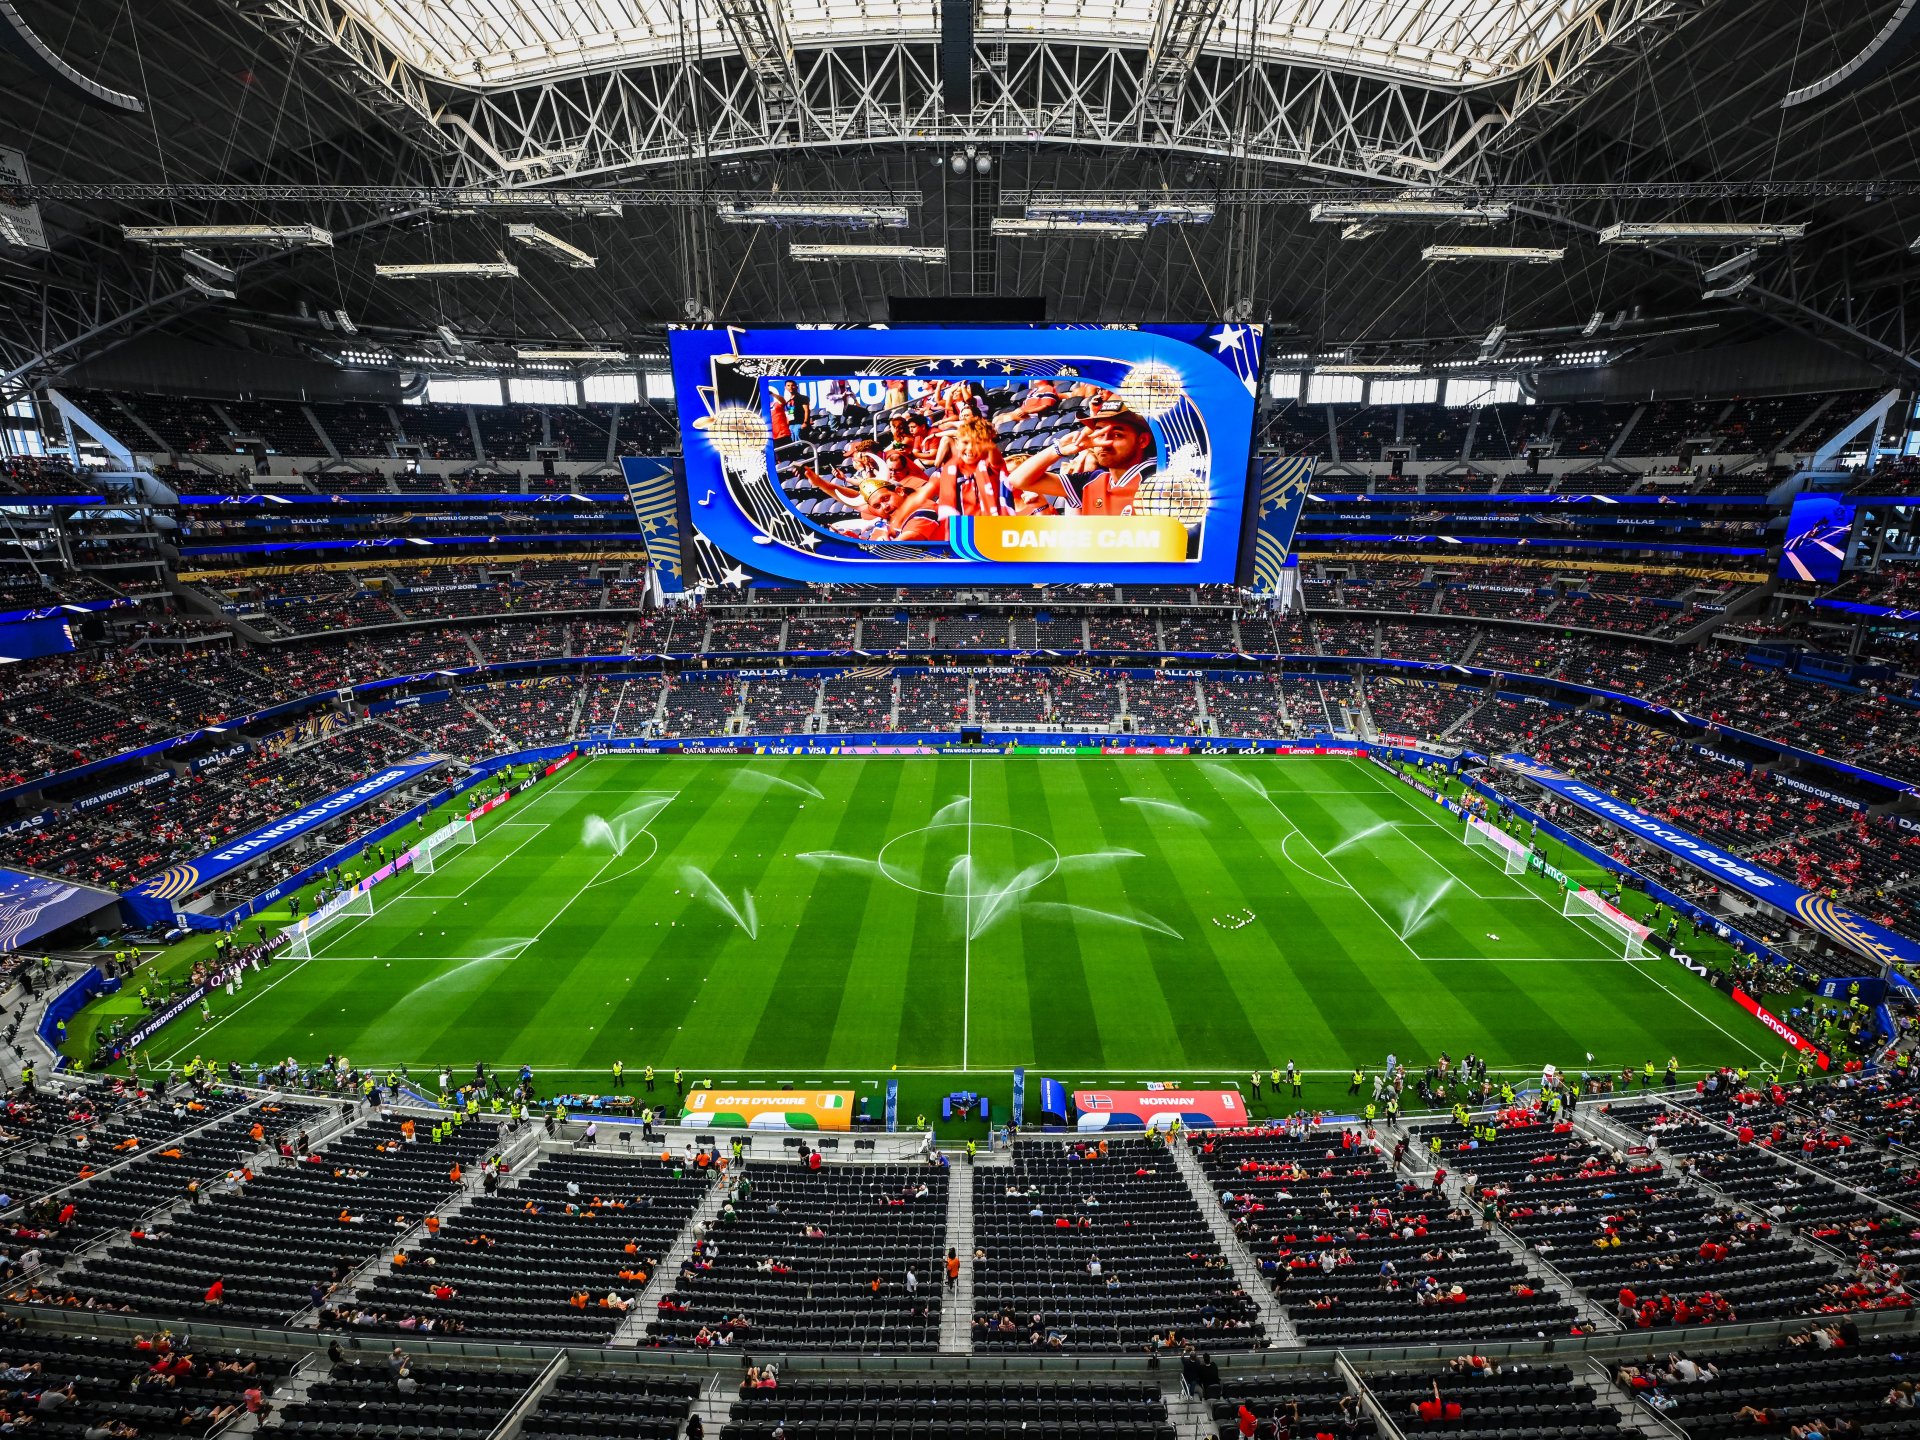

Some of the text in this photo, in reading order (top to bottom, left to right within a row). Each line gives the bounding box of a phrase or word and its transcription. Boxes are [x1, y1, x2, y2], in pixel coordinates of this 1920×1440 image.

[1001, 530, 1160, 548] DANCE CAM
[198, 746, 245, 767] DALLAS
[807, 747, 826, 755] VISA
[1699, 747, 1746, 768] DALLAS
[80, 772, 170, 808] FIFA WORLD CUP 2026
[455, 782, 464, 792] FIFA
[1787, 779, 1814, 794] WORLD
[1814, 788, 1831, 799] CUP
[1831, 794, 1860, 810] 2026
[212, 770, 406, 862] FIFA WORLD CUP 2026
[1564, 786, 1775, 887] FIFA WORLD CUP 2026
[265, 888, 281, 901] FIFA
[145, 986, 205, 1036] PREDICTSTREET
[1755, 1006, 1798, 1046] Lenovo
[715, 1095, 807, 1105] CÔTE D'IVOIRE
[1139, 1097, 1195, 1105] NORWAY
